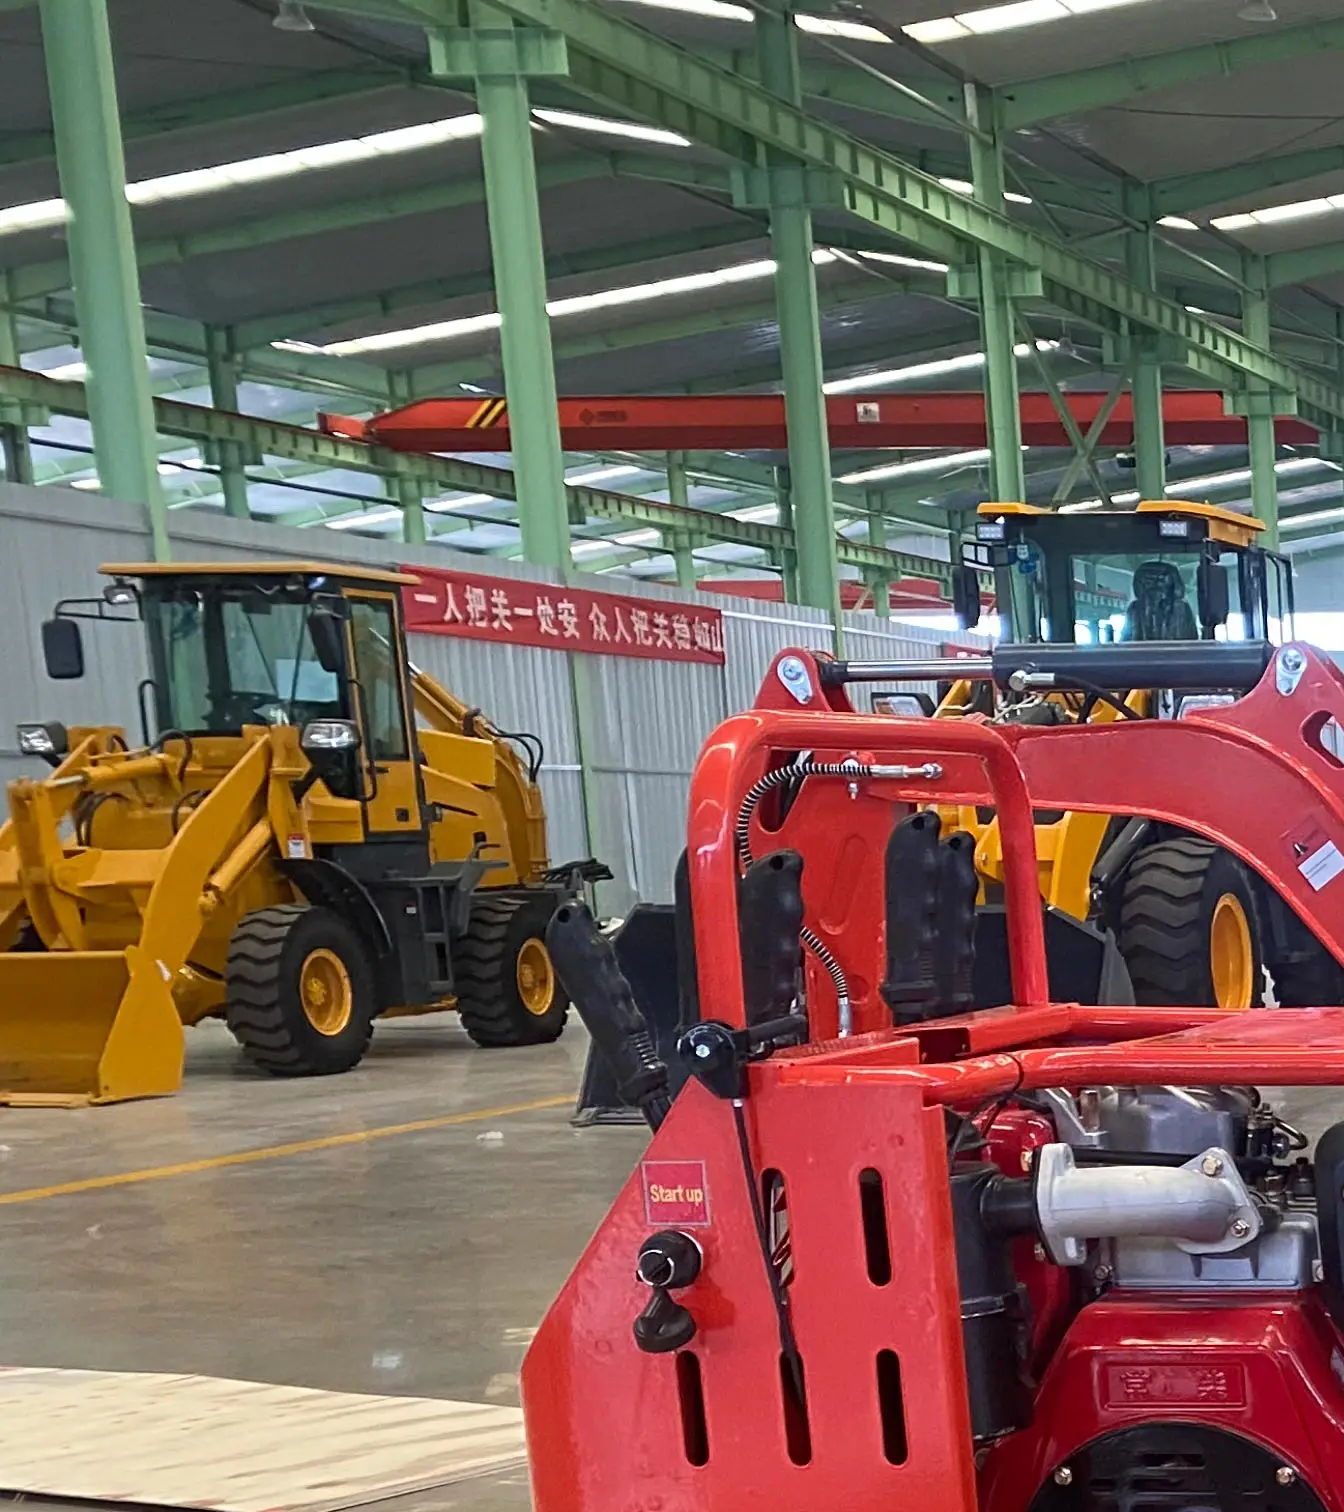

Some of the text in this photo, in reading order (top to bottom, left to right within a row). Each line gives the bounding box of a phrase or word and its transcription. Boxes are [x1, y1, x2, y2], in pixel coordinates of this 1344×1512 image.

[414, 583, 723, 651] 一人把关一处安 众人把关稳如山
[650, 1184, 704, 1207] Start up
